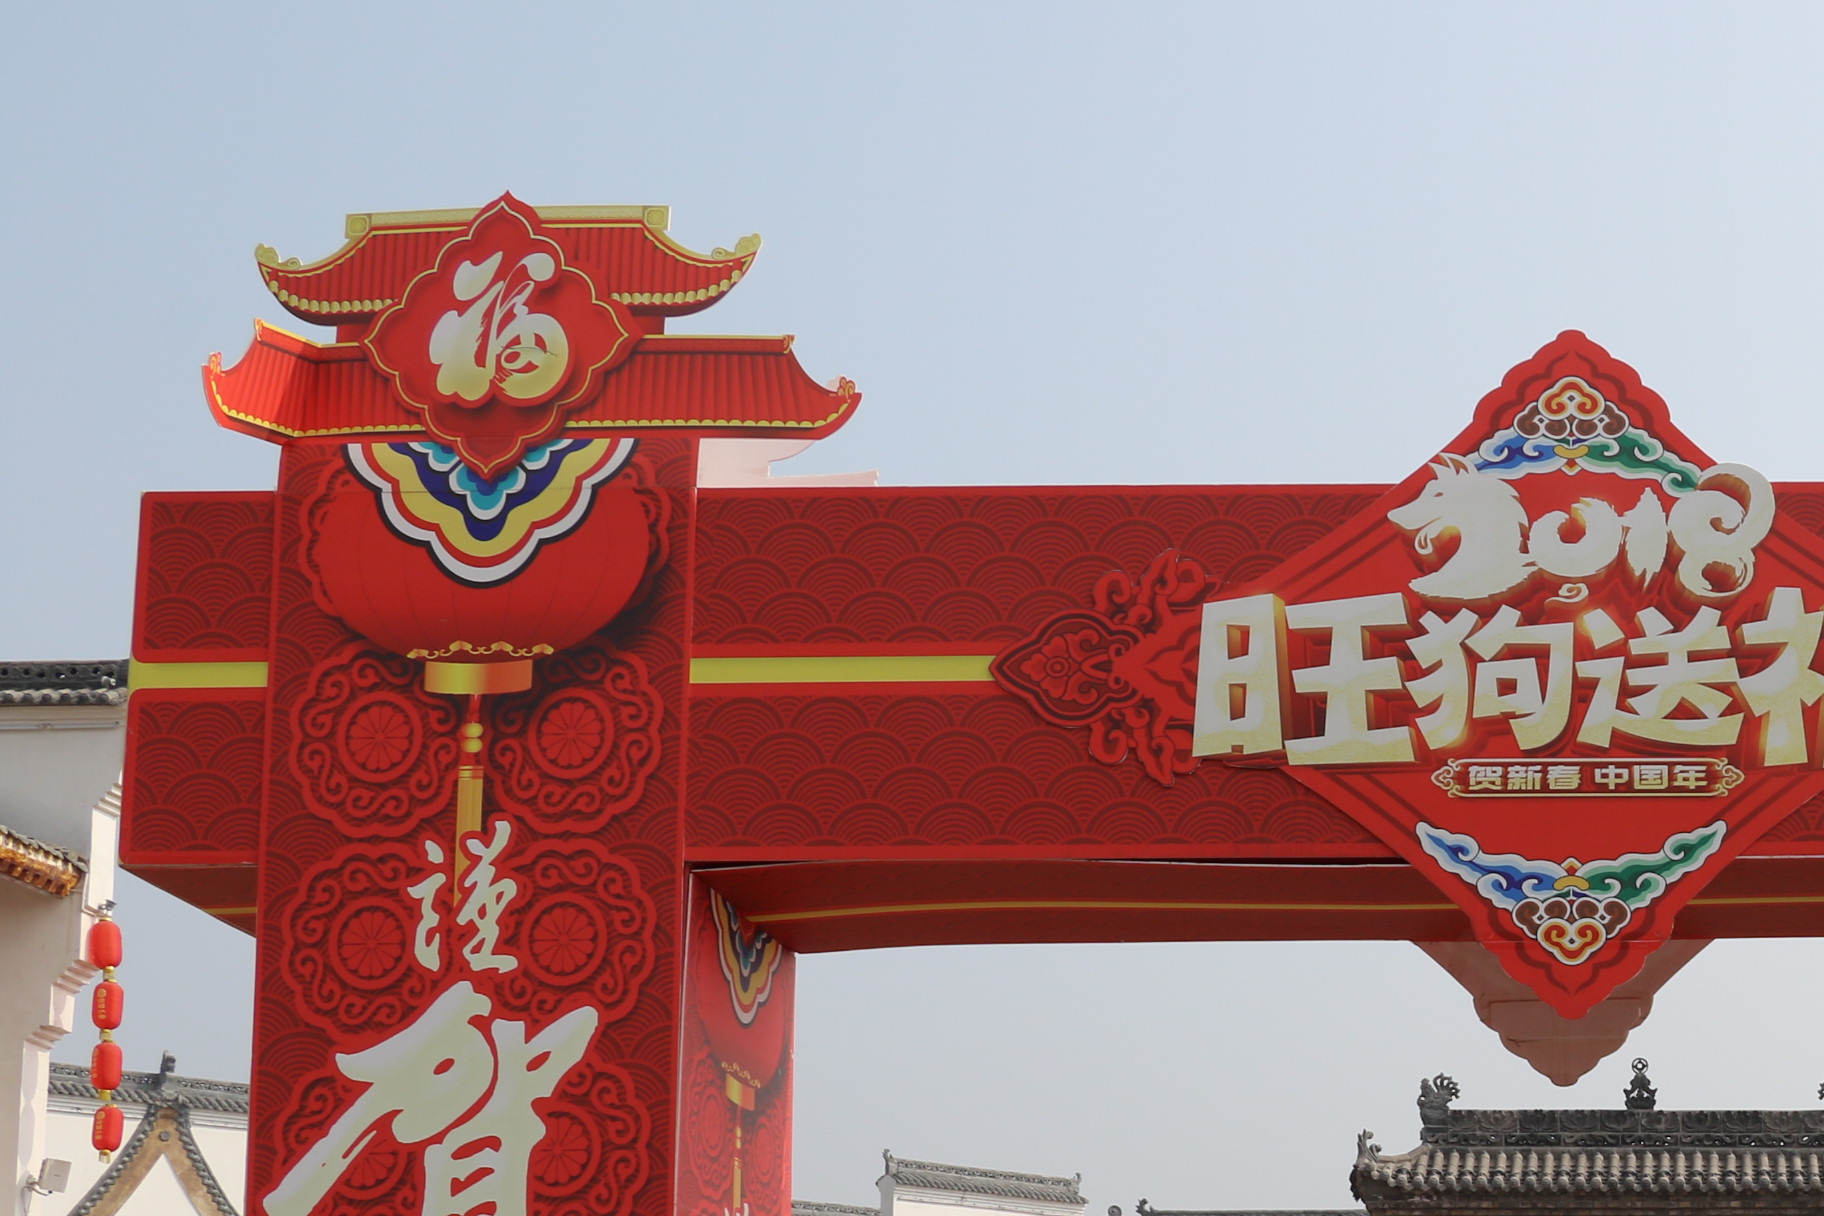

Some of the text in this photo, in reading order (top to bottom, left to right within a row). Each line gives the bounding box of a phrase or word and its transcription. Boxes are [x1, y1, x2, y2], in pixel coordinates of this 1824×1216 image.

[428, 250, 570, 401] 福
[1387, 452, 1776, 600] 2018
[1467, 764, 1709, 791] 贺新春 中国年
